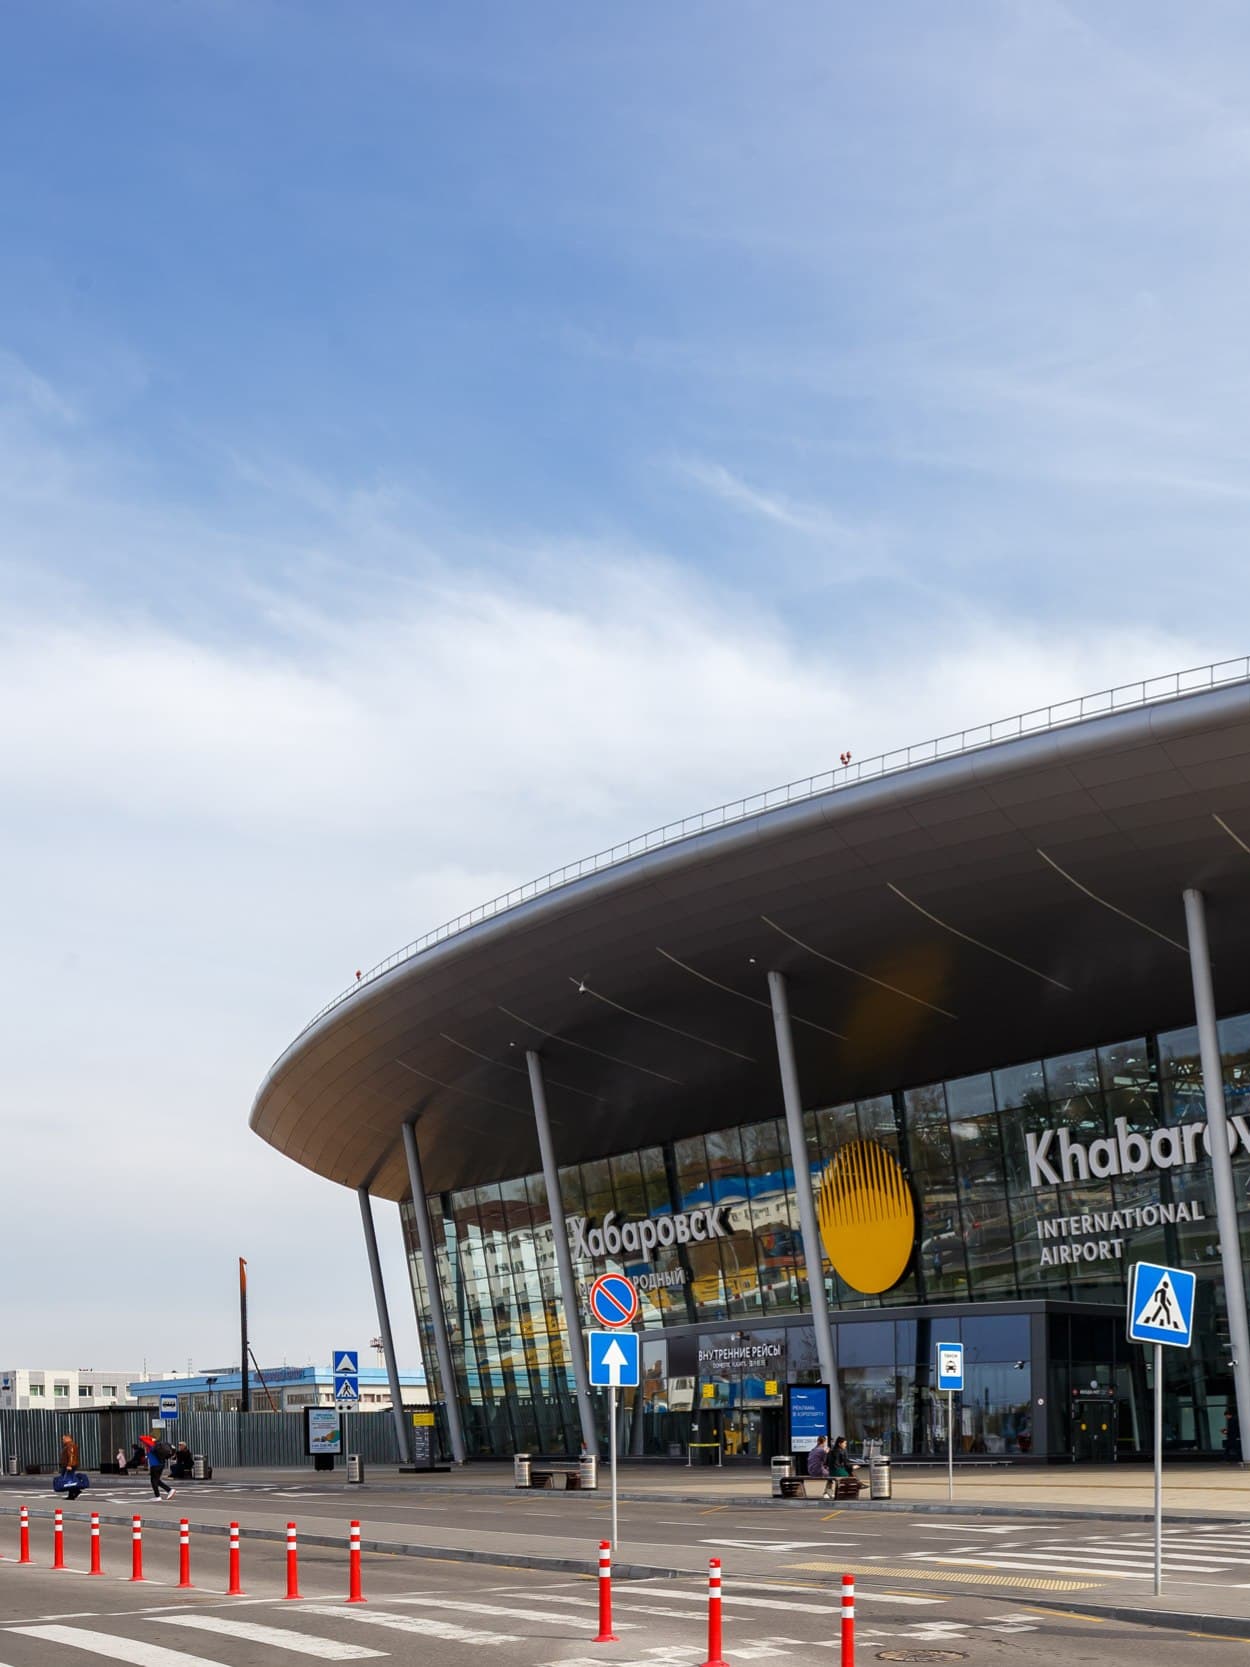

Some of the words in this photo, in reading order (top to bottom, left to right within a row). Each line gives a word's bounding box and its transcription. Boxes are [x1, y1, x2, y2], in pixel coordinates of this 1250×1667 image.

[567, 1210, 726, 1263] Хабаровск
[1037, 1200, 1206, 1240] INTERNATIONAL
[1040, 1238, 1125, 1266] AIRPORT
[698, 1346, 750, 1362] ВНУТРЕННИЕ
[751, 1343, 781, 1359] РЕЙСЫ
